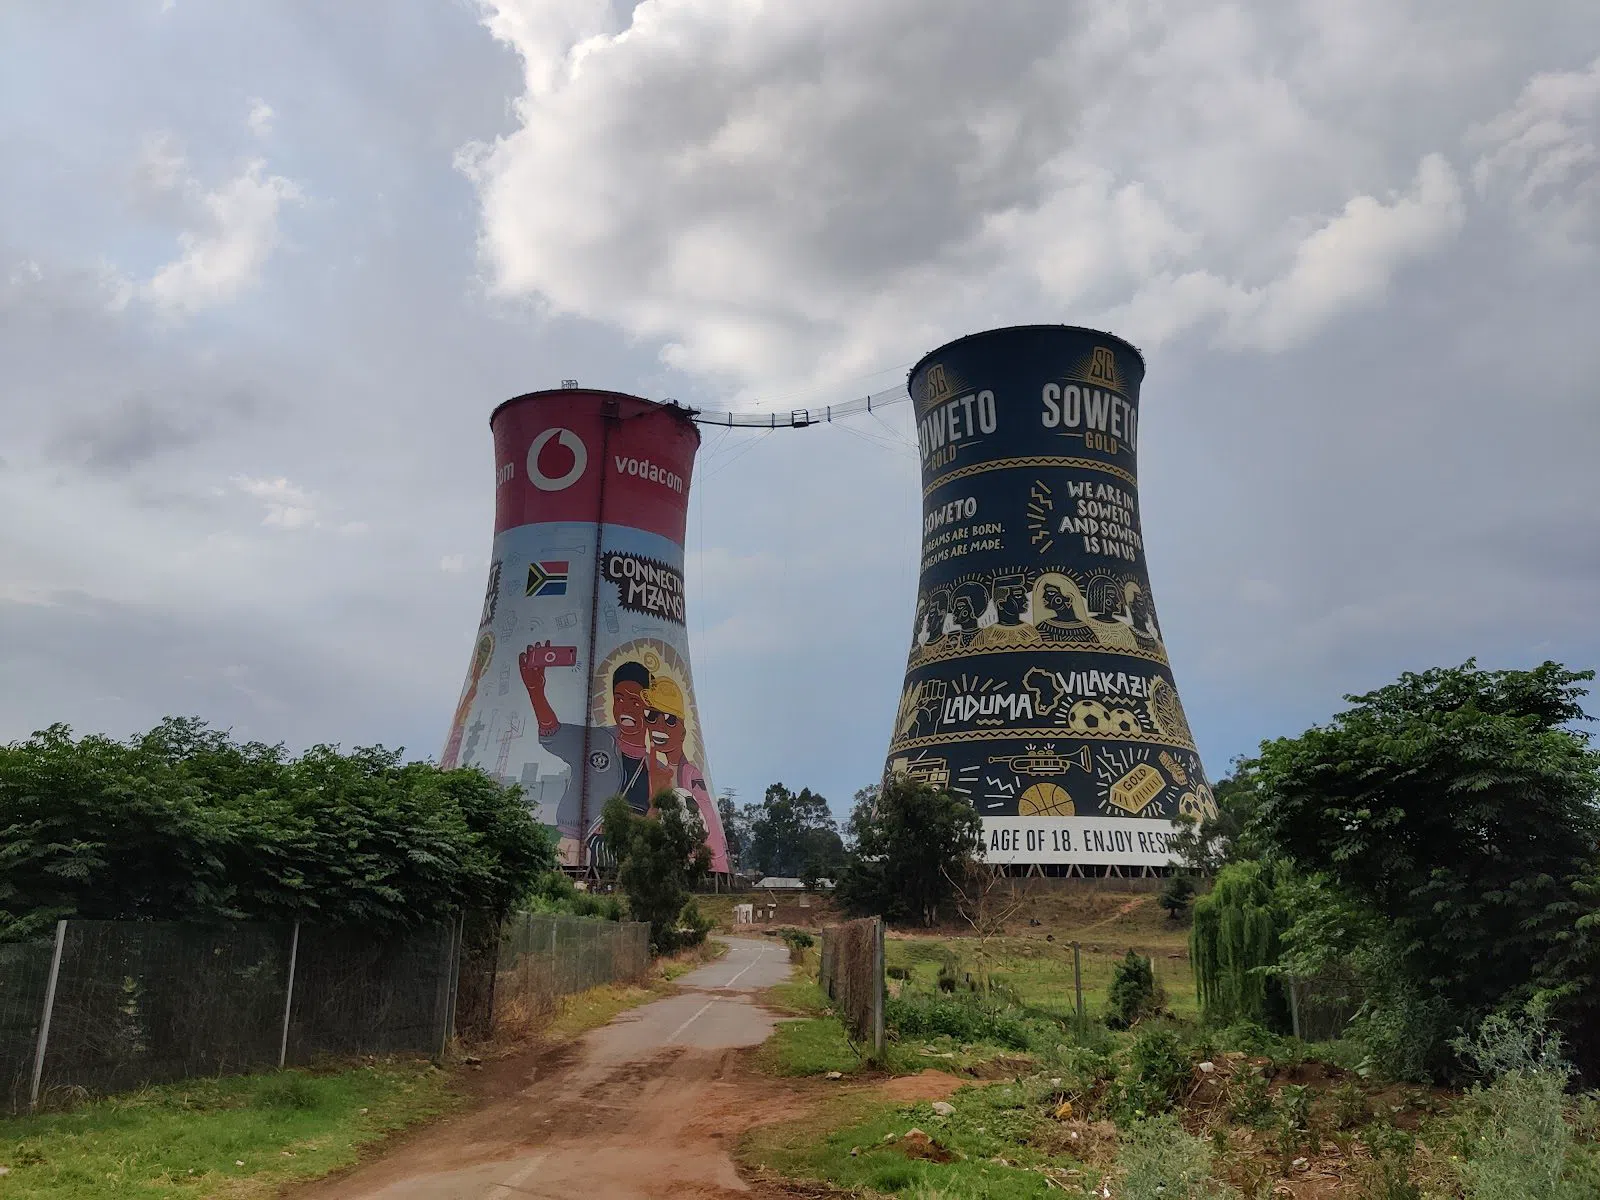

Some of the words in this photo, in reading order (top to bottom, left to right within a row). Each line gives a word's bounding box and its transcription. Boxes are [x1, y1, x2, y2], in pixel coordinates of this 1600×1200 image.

[1042, 382, 1137, 452] SOWETO
[1085, 431, 1117, 455] GOLD
[932, 444, 957, 471] GOLD
[615, 455, 683, 494] vodacom
[1067, 481, 1093, 499] WE
[1095, 483, 1122, 505] ARE
[1123, 492, 1134, 512] IN
[924, 497, 977, 537] SOWETO
[1077, 499, 1131, 527] SOWETO
[951, 527, 969, 542] ARE
[972, 522, 1005, 537] BORN.
[1058, 516, 1099, 535] AND
[1100, 521, 1142, 550] SOWETO
[950, 544, 968, 558] ARE
[970, 538, 1005, 552] MADE.
[1083, 536, 1100, 554] IS
[1102, 538, 1120, 558] IN
[1120, 542, 1136, 562] US
[627, 578, 684, 622] MZANSI
[1056, 669, 1147, 698] VILAKAZI
[943, 693, 1033, 724] LADUMA
[1122, 768, 1147, 792] GOLD
[990, 829, 1020, 851] AGE
[1026, 829, 1045, 851] OF
[1052, 829, 1078, 852] 18.
[1083, 829, 1133, 853] ENJOY
